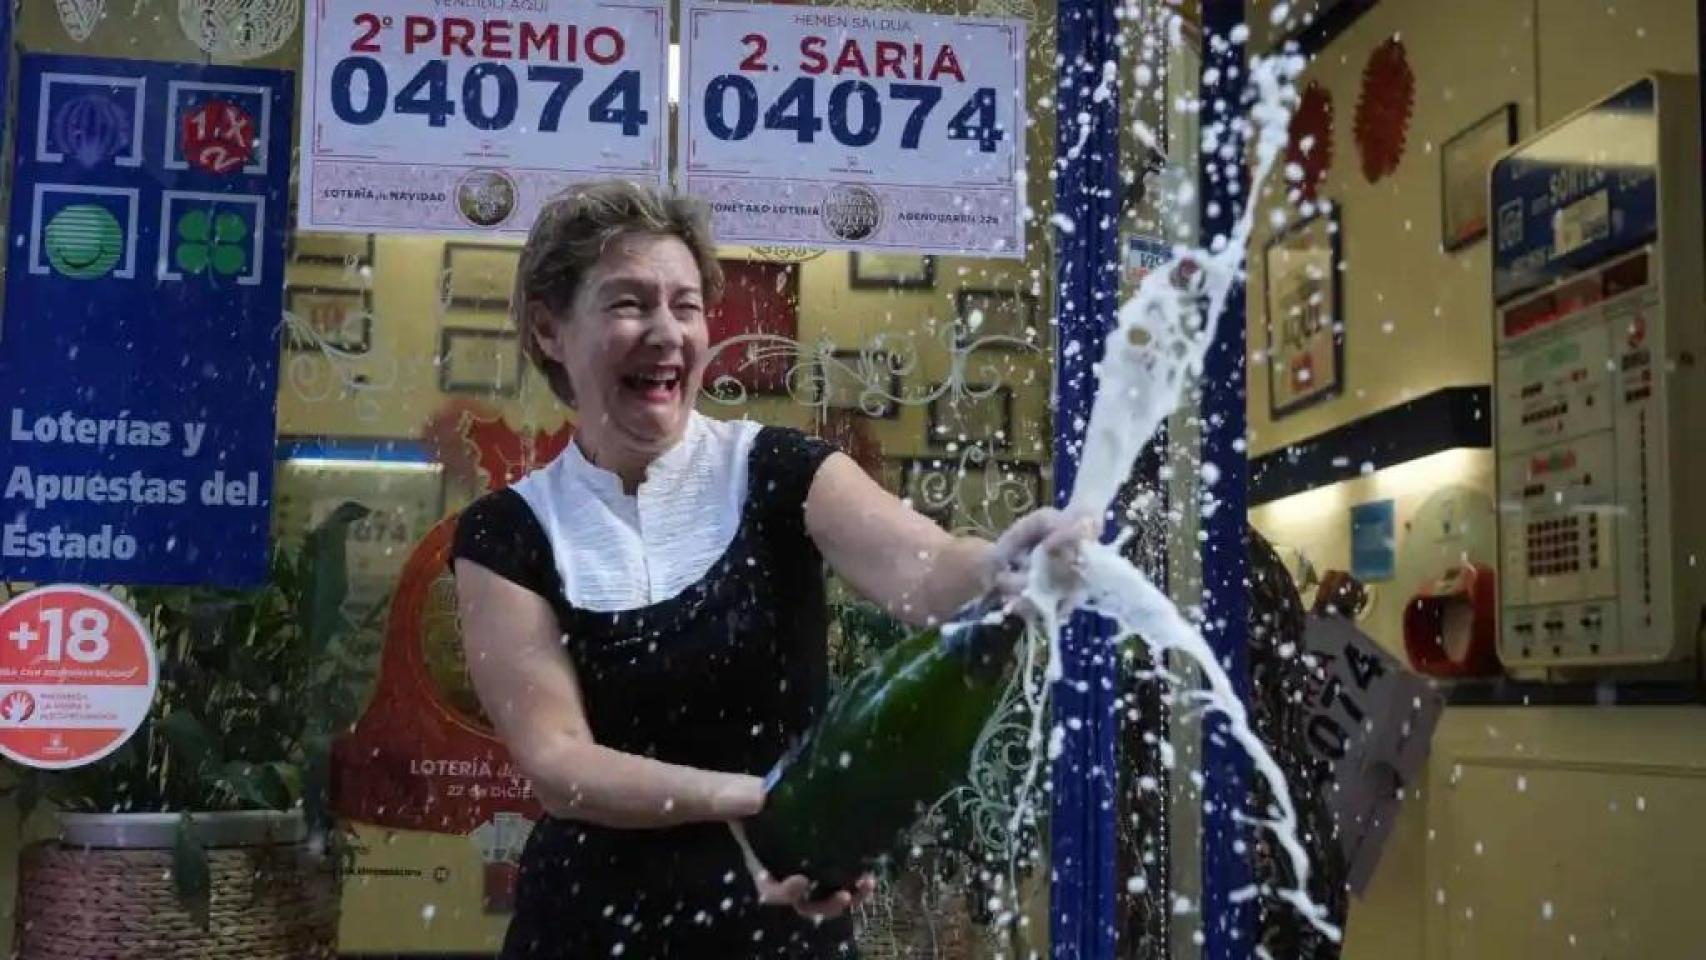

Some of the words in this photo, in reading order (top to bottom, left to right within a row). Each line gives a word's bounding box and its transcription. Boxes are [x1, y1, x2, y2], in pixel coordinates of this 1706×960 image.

[404, 15, 626, 65] PREMIO
[793, 14, 847, 28] HEMEN
[739, 33, 780, 73] 2.
[799, 35, 966, 83] SARIA
[330, 55, 649, 138] 04074
[703, 73, 1005, 153] 04074
[389, 191, 447, 203] NAVIDAD
[11, 407, 171, 446] Loterías
[182, 421, 207, 457] y
[5, 465, 188, 509] Apuestas
[199, 470, 260, 507] del
[2, 523, 137, 560] Estado
[8, 607, 111, 662] +18
[410, 758, 491, 777] LOTERÍA
[446, 784, 465, 797] 22
